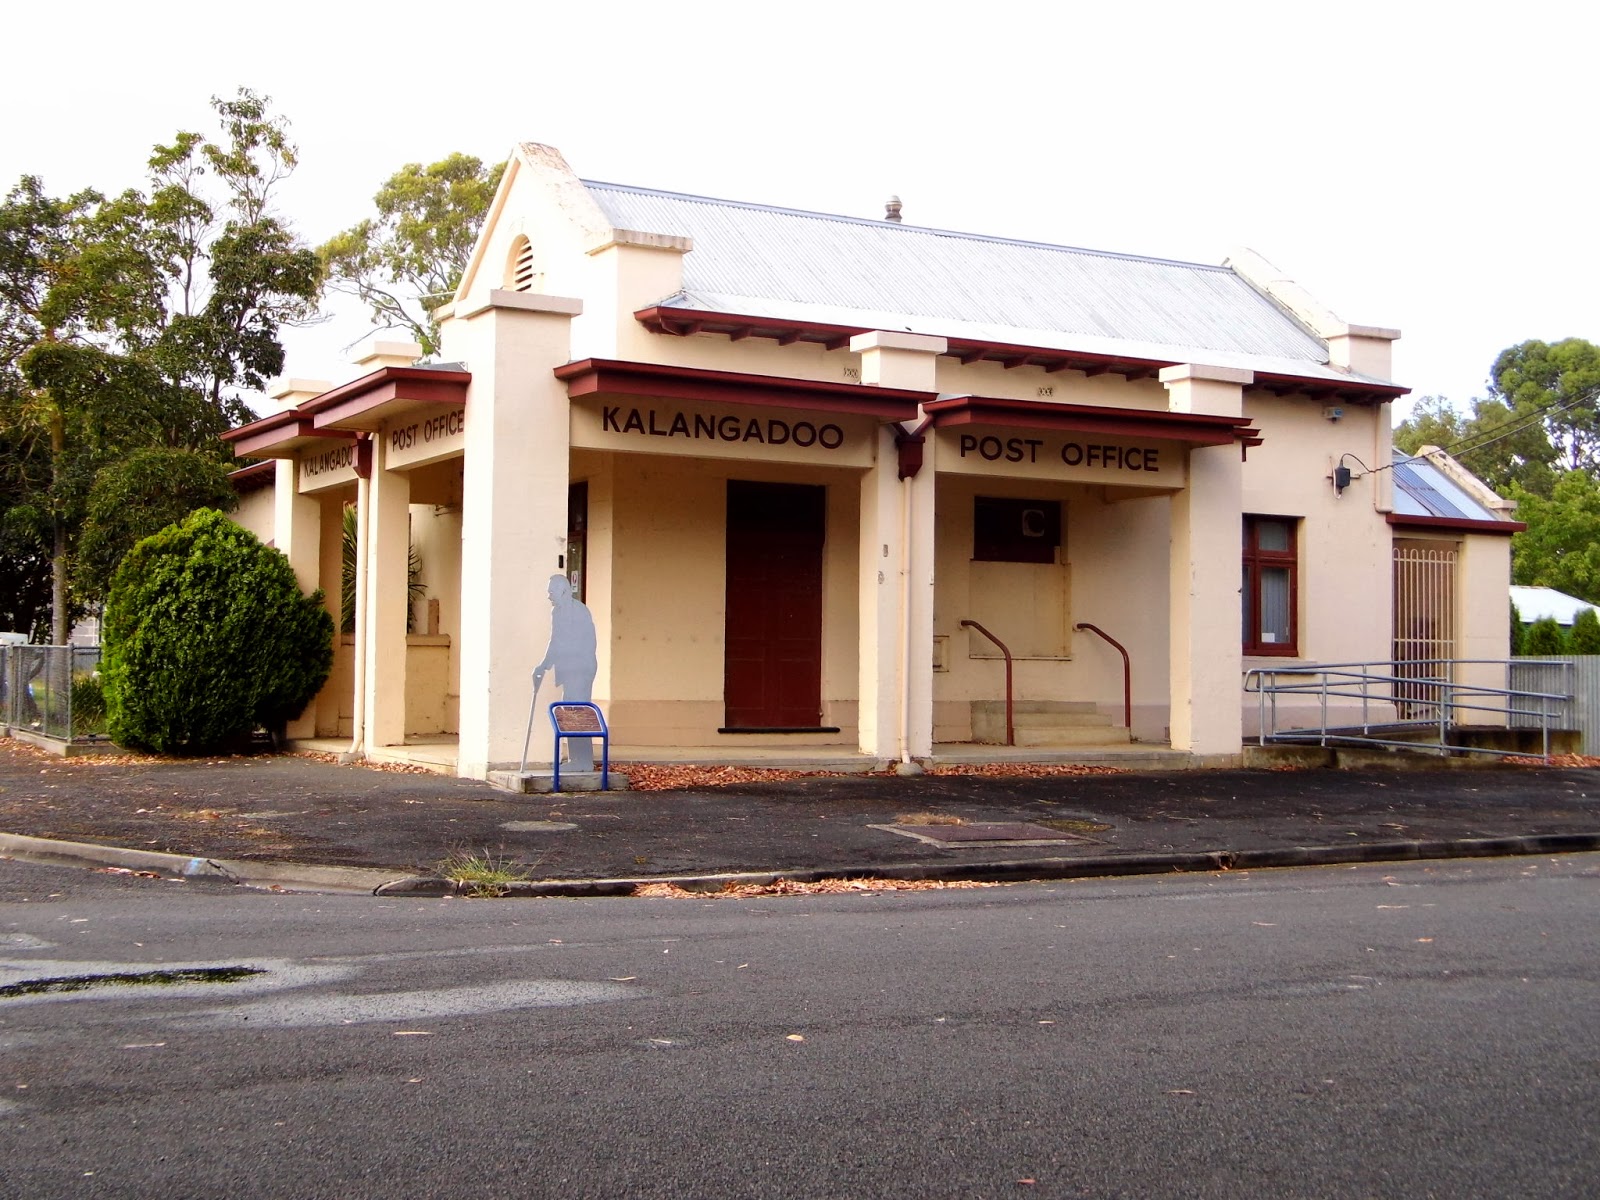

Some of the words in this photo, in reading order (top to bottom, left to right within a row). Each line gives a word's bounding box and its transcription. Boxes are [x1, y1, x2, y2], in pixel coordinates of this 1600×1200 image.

[392, 424, 418, 452] POST
[424, 409, 465, 443] OFFICE
[602, 406, 844, 449] KALANGADOO
[304, 445, 353, 478] KALANGADO
[960, 434, 1043, 463] POST
[1061, 442, 1159, 471] OFFICE
